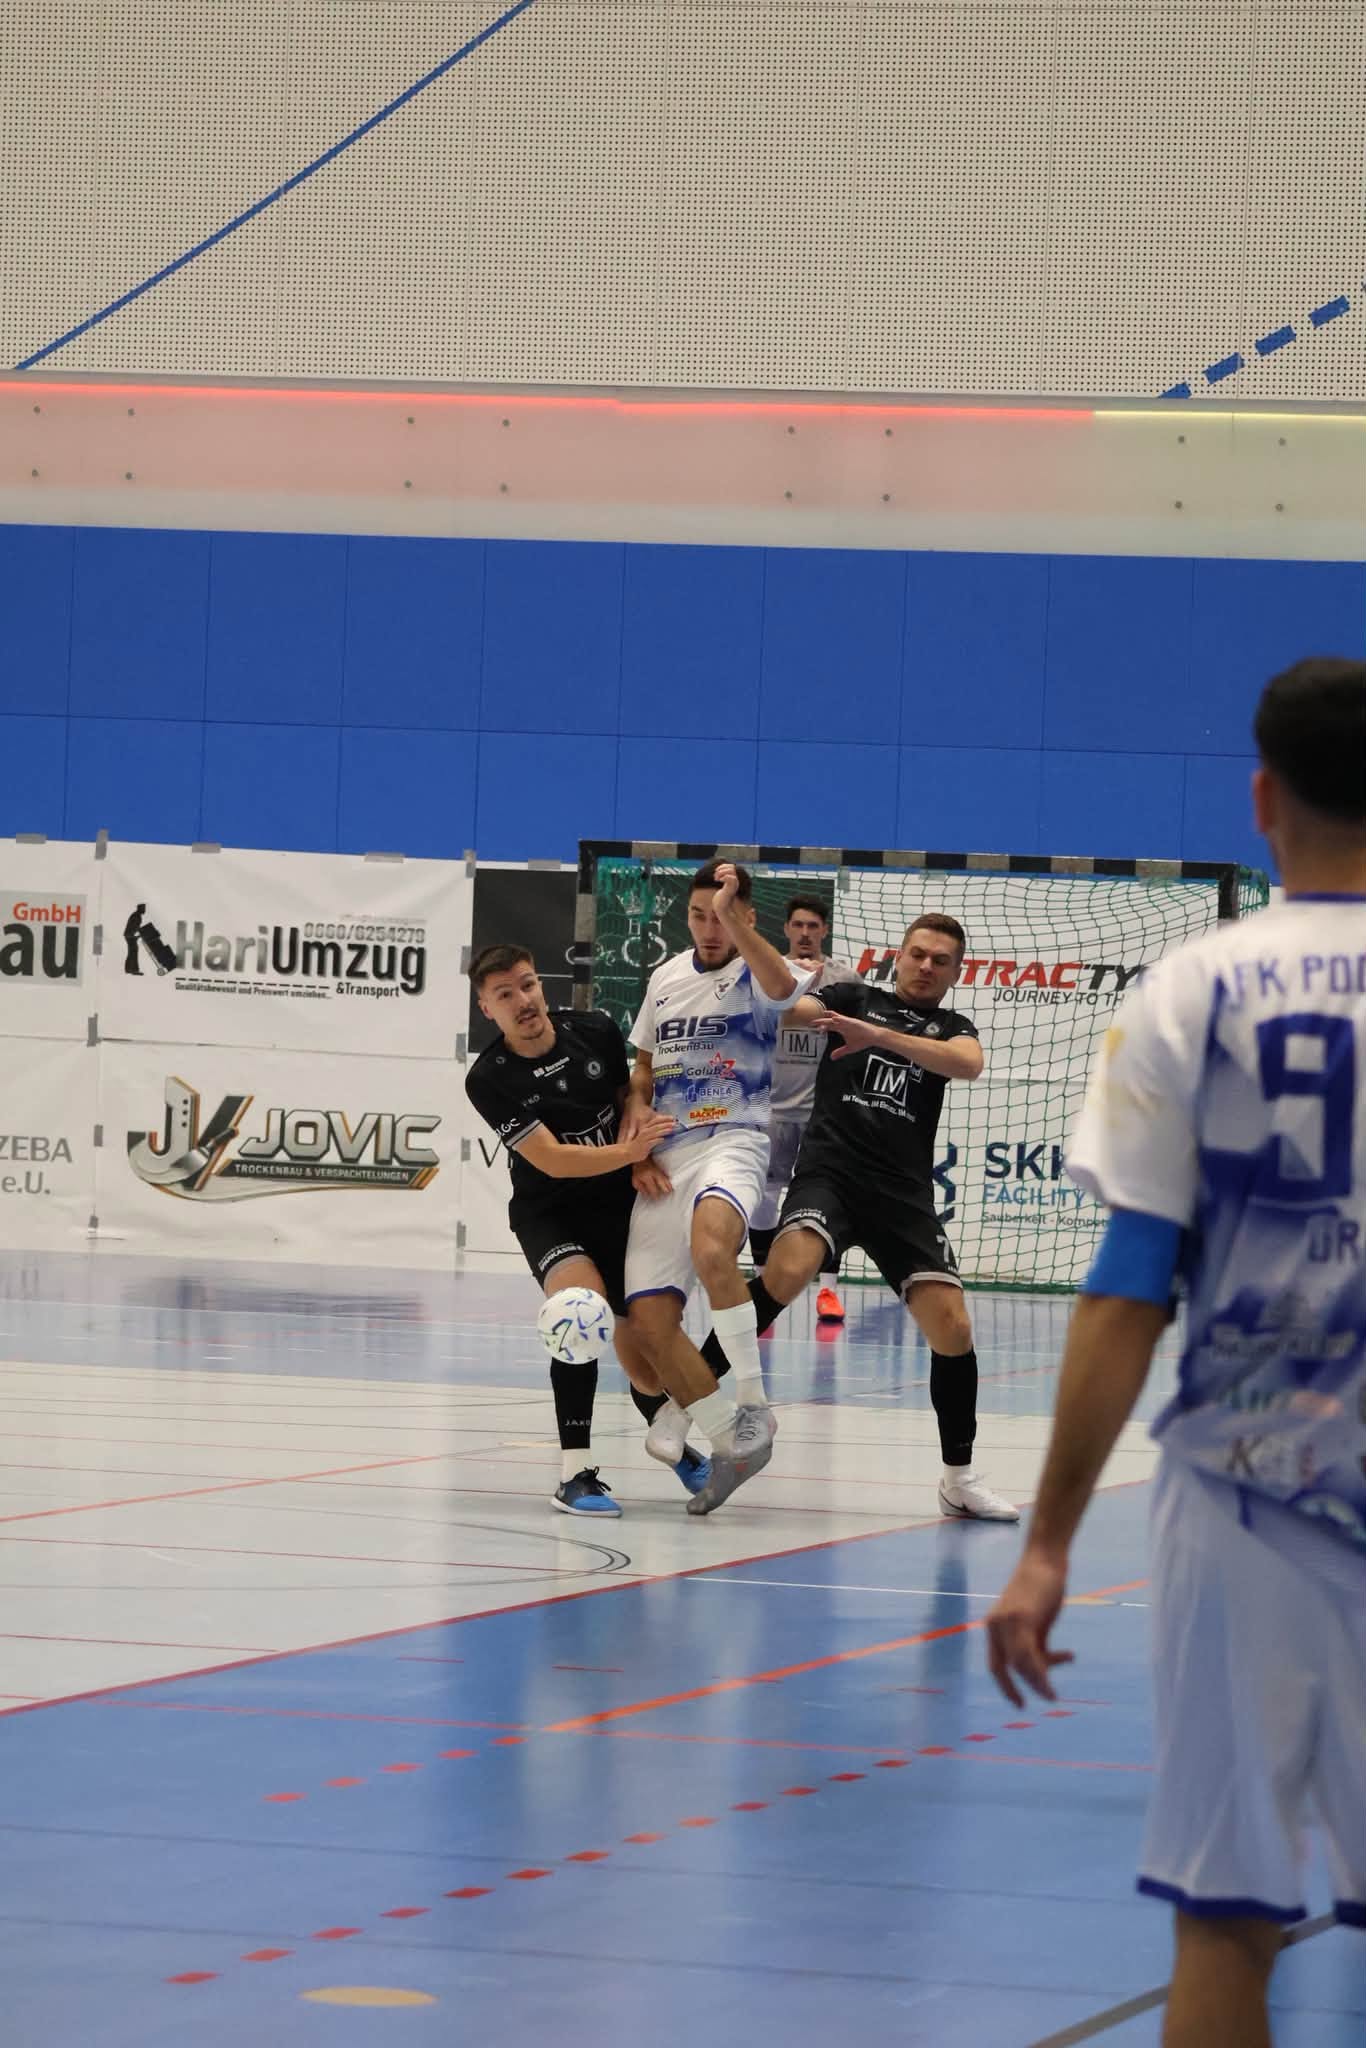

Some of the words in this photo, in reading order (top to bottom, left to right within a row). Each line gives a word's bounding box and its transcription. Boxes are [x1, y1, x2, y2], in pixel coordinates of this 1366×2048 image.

[13, 902, 82, 923] GmbH
[0, 921, 80, 979] au
[1302, 953, 1366, 994] PO
[992, 989, 1073, 1005] JOURNEY
[1076, 992, 1099, 1006] TO
[655, 1014, 728, 1044] BIS
[789, 1033, 809, 1053] IM
[872, 1064, 907, 1095] IM
[1255, 1012, 1355, 1202] 9
[238, 1108, 442, 1167] JOVIC
[1, 1171, 51, 1195] e.U.
[234, 1164, 301, 1177] TROCKENBAU
[315, 1167, 409, 1181] VERSPACHTELUNGEN
[983, 1184, 1087, 1208] FACILITY
[982, 1212, 1047, 1225] Sauberkeit
